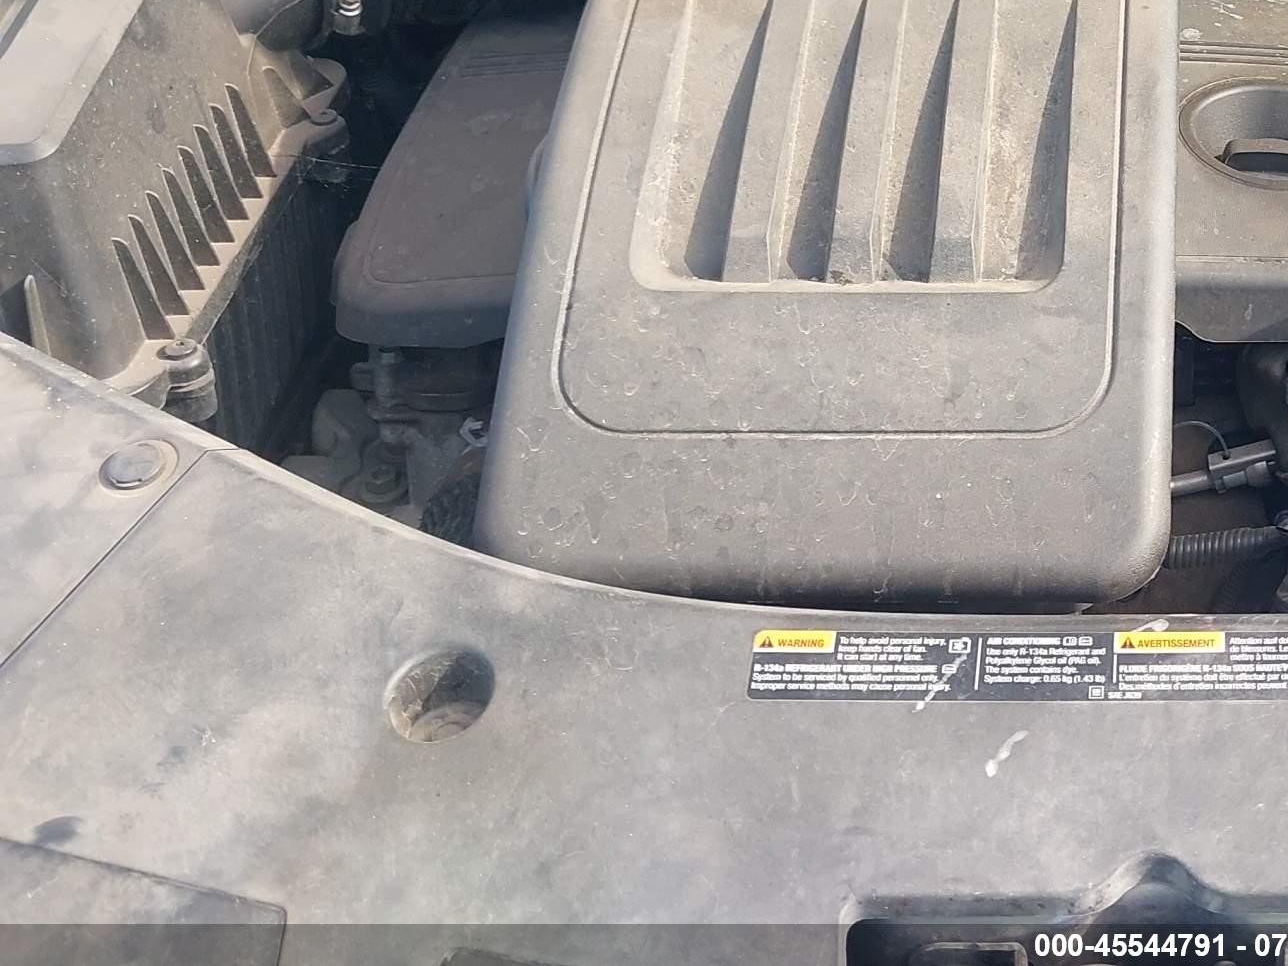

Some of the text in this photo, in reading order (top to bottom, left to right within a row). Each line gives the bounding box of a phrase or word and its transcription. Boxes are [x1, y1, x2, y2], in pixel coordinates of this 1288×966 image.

[778, 639, 824, 647] WARNING
[849, 637, 867, 645] help
[890, 637, 922, 645] personal
[1137, 639, 1216, 648] AVERTISSEMENT
[1002, 648, 1018, 656] only
[1048, 648, 1090, 656] Refrigerant
[1033, 657, 1056, 666] Glycol
[1068, 657, 1086, 666] (PAG
[754, 664, 938, 672] R-134a REFRIGERANT UNDER HIGH PRESSURE
[1000, 666, 1028, 674] system
[1062, 666, 1079, 674] dye.
[1119, 664, 1148, 672] FLUIDE
[1202, 664, 1232, 672] R-134a
[752, 673, 782, 682] System
[837, 674, 848, 682] by
[848, 673, 881, 682] qualified
[882, 674, 920, 682] personnel
[921, 674, 938, 682] only.
[984, 675, 1012, 683] System
[1014, 675, 1042, 683] charge:
[1062, 675, 1072, 683] kg
[1073, 675, 1094, 683] (1.43
[1094, 675, 1106, 683] lb)
